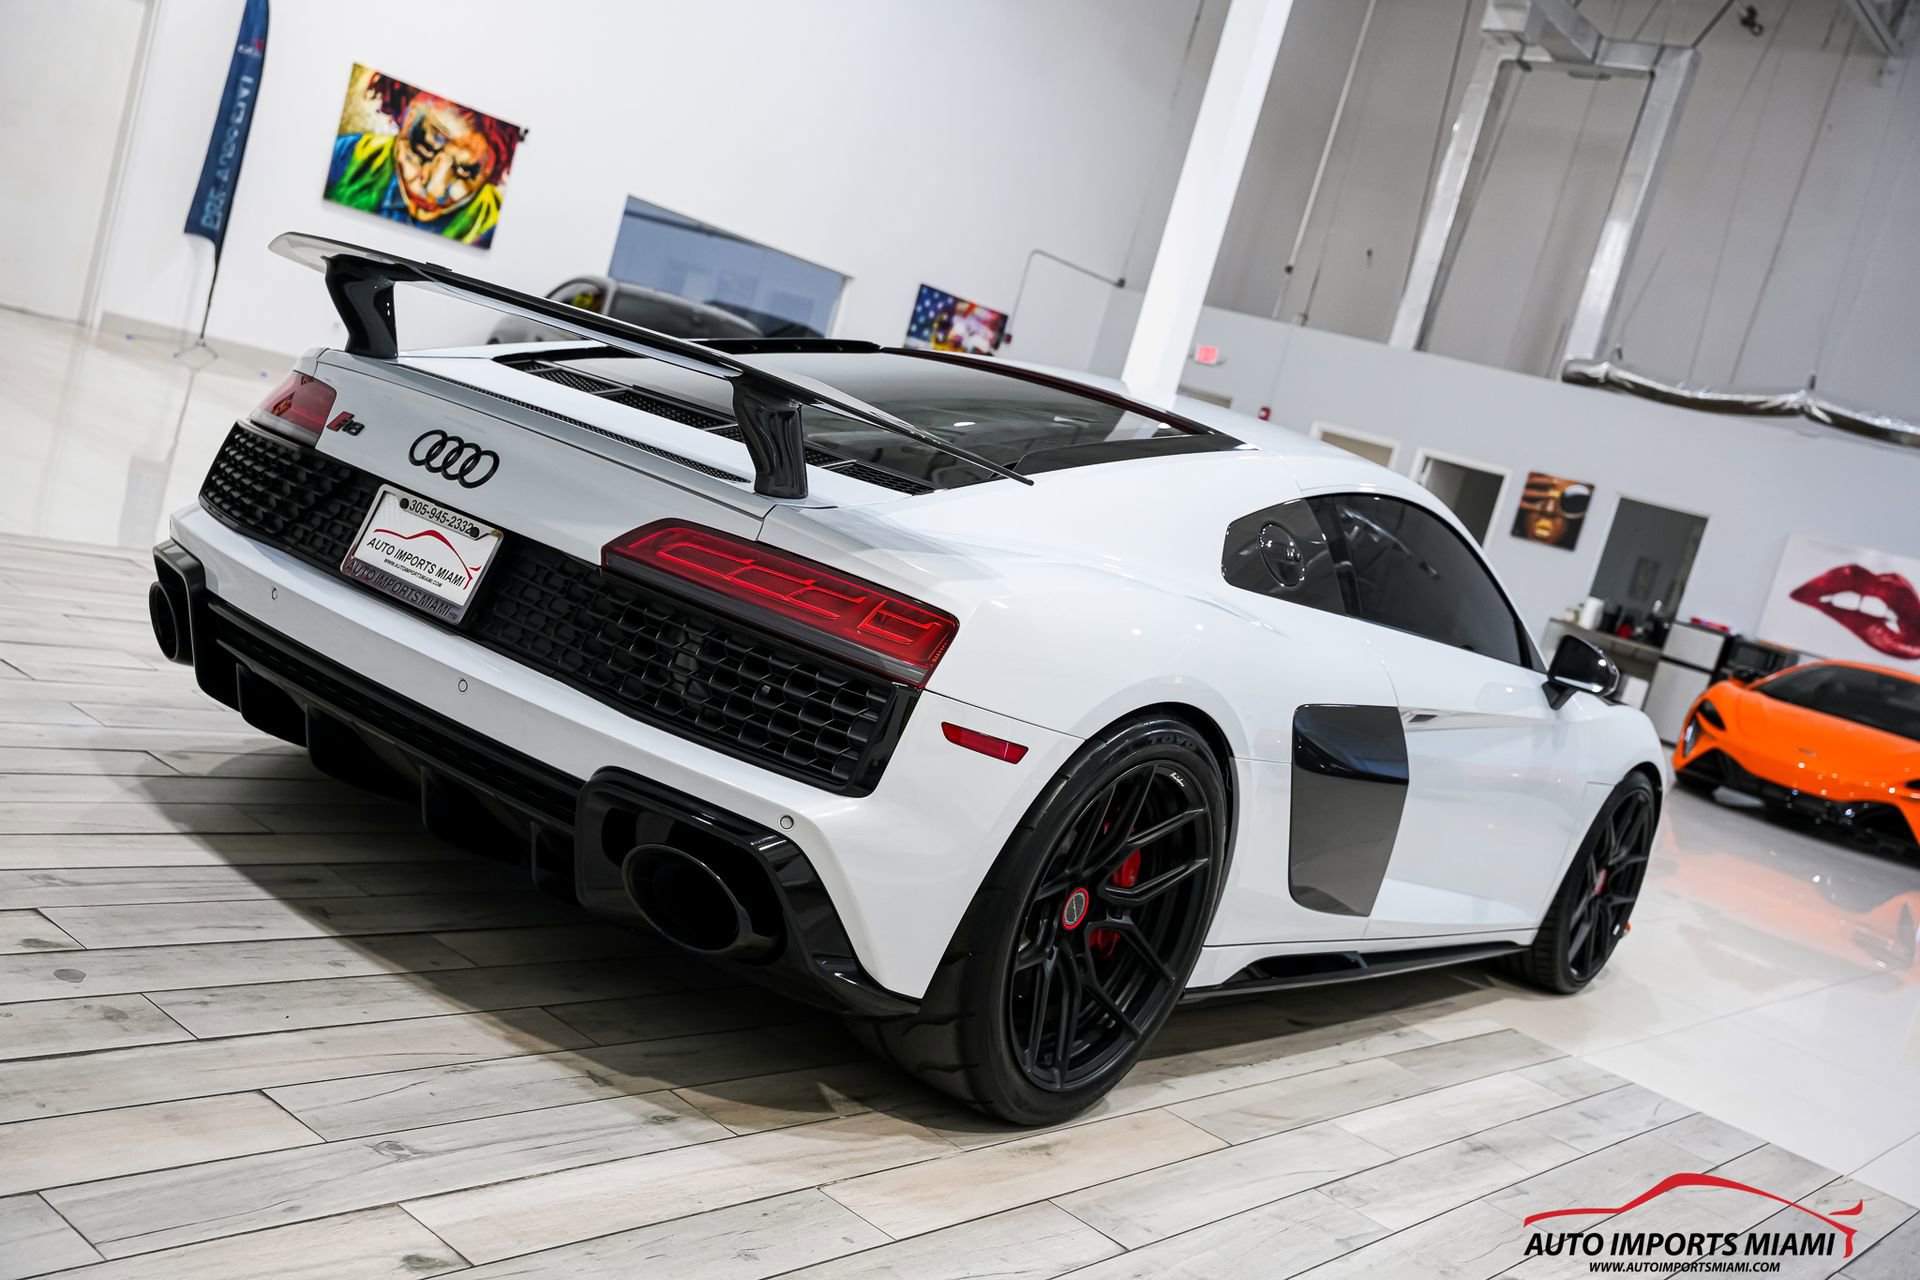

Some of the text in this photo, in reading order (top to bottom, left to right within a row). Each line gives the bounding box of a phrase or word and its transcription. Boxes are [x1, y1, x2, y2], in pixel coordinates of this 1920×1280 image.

[409, 499, 473, 534] 305-945-2332
[366, 537, 466, 587] AUTO IMPORTS MIAMI
[384, 557, 444, 588] WWW.AUTOIMPORTSMIAMI.COM
[346, 560, 376, 580] AUTO
[373, 573, 421, 601] IMPORTS
[417, 595, 452, 617] MIAMI
[1148, 733, 1198, 752] TOYO
